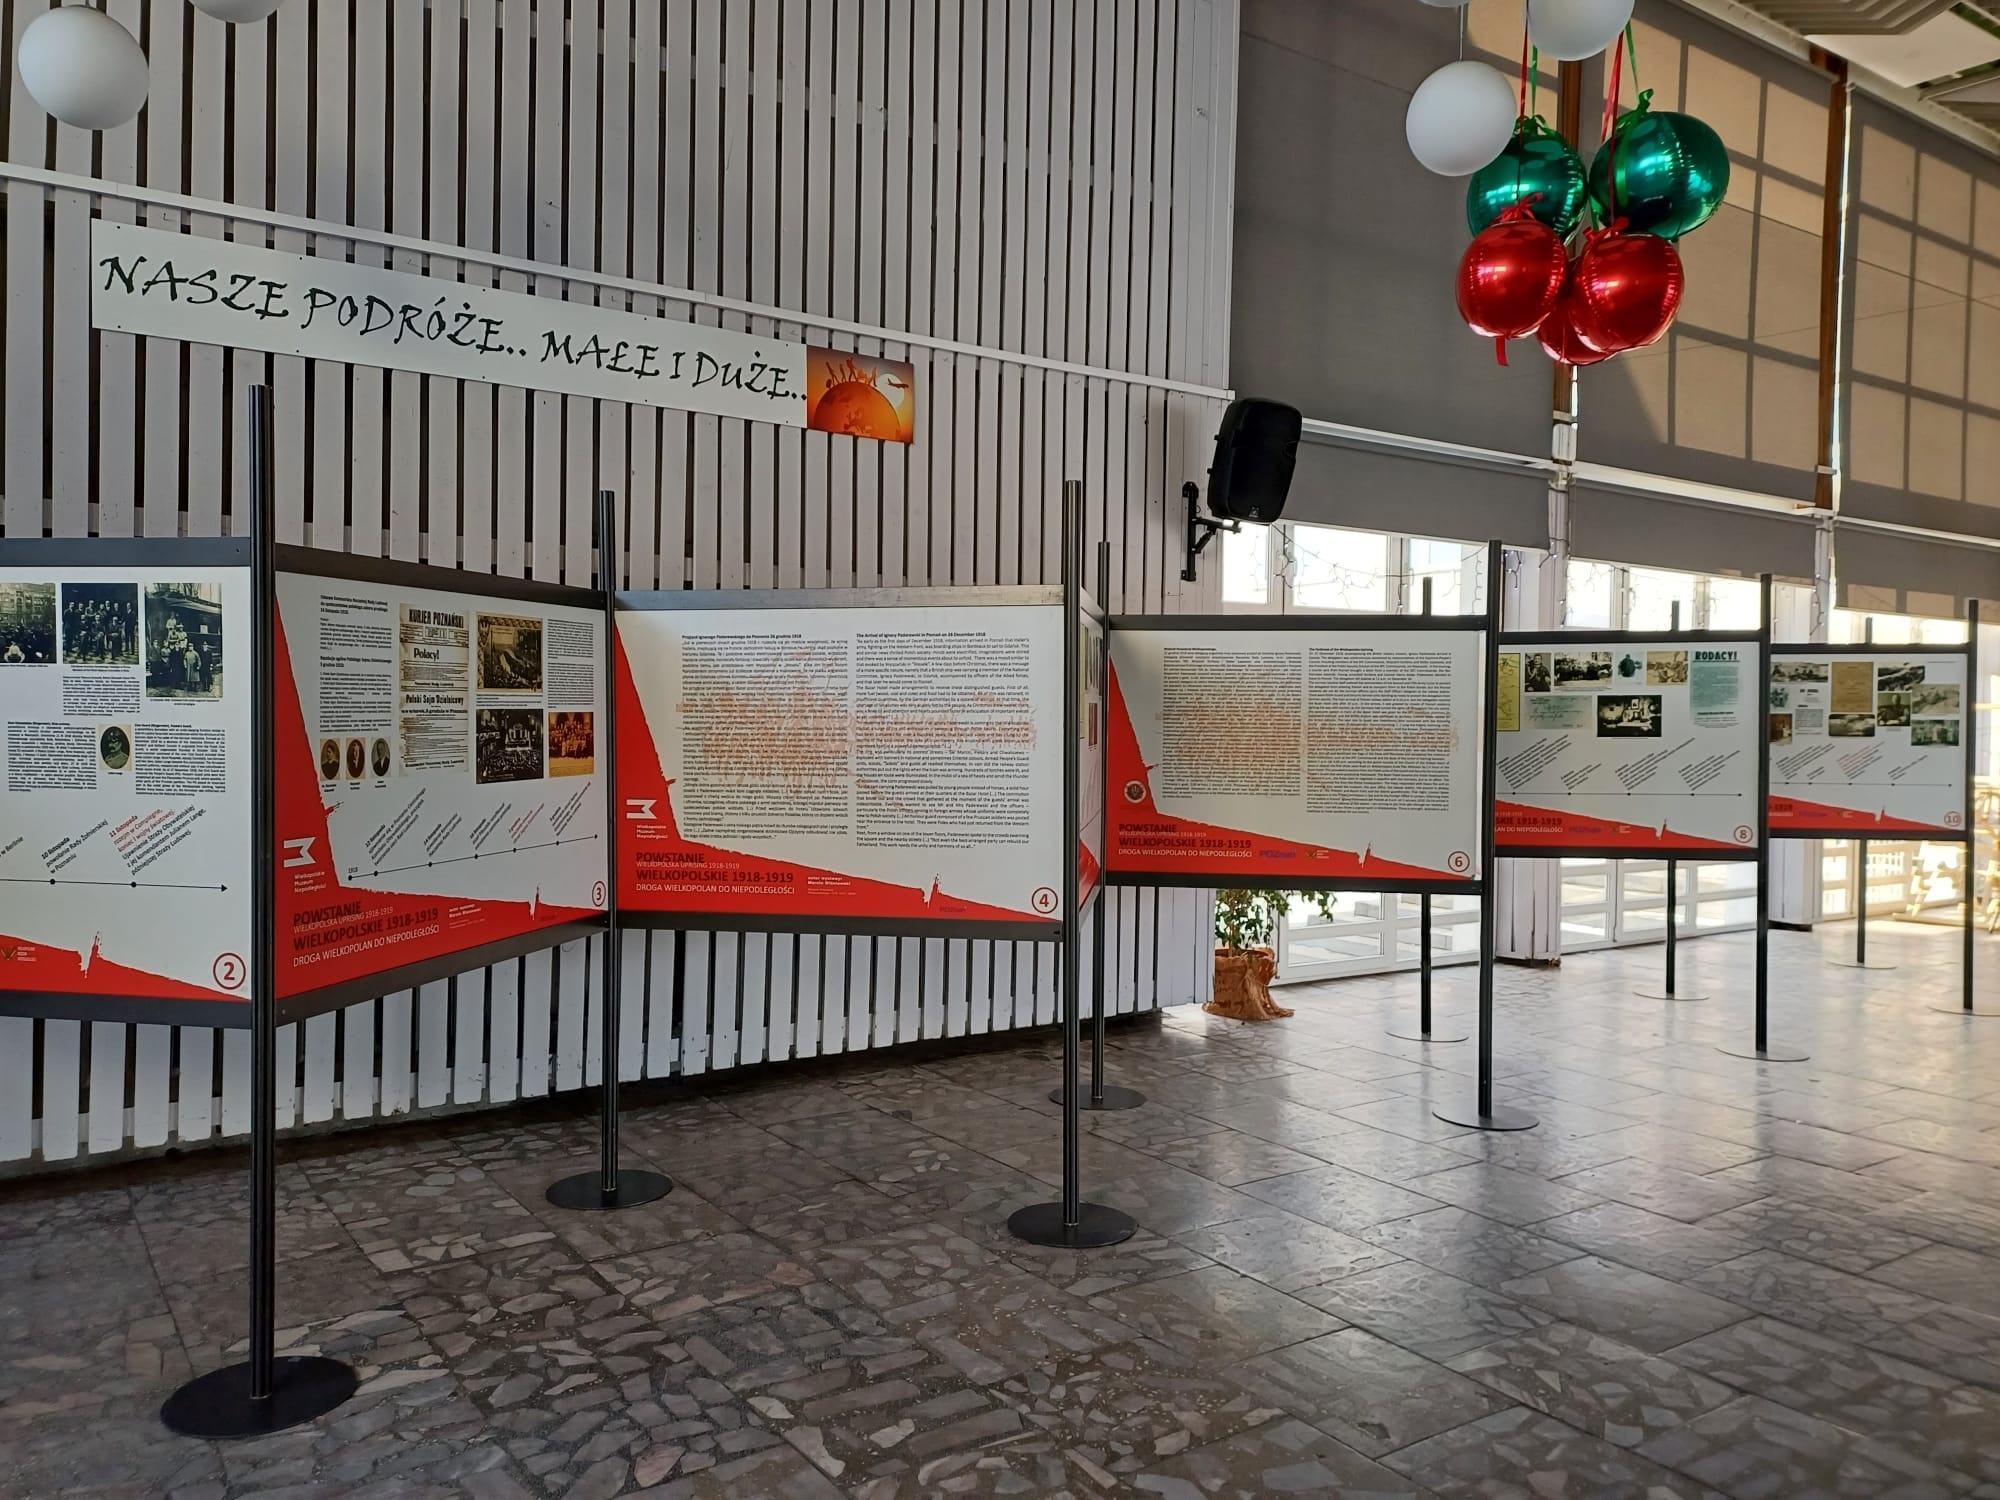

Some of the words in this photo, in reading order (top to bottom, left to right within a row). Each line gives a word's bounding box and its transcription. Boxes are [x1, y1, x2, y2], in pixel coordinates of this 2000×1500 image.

[100, 256, 289, 319] NASZE
[300, 287, 527, 357] PODRÓŻE..
[540, 330, 659, 379] MAŁE
[669, 351, 685, 379] I
[691, 350, 807, 400] DUŻE..
[409, 609, 431, 624] KURJER
[433, 612, 464, 628] POZNAŃSKI
[1695, 651, 1738, 660] RODACY!
[1947, 815, 1959, 824] 10
[1118, 824, 1177, 832] POWSTANIE
[1118, 838, 1197, 848] WIELKOPOLSKIE
[1199, 839, 1252, 849] 1918-1919
[636, 852, 704, 863] POWSTANIE
[1199, 849, 1253, 858] NIEPODLEGŁOŚCI
[1455, 856, 1463, 867] 6
[636, 870, 728, 882] WIELKOPOLSKIE
[732, 872, 793, 883] 1918-1919
[596, 887, 602, 901] 3
[636, 884, 662, 892] DROGA
[664, 884, 716, 893] WIELKOPOLAN
[718, 885, 730, 893] DO
[731, 885, 795, 895] NIEPODLEGŁOŚCI
[1039, 893, 1049, 908] 4
[292, 901, 361, 926] POWSTANIE
[365, 906, 393, 919] 1918-1919
[293, 920, 383, 951] WIELKOPOLSKIE
[386, 908, 438, 930] 1918-1919
[293, 954, 320, 967] DROGA
[322, 940, 373, 960] WIELKOPOLAN
[374, 937, 385, 948] DO
[386, 924, 440, 944] NIEPODLEGŁOŚCI
[223, 961, 235, 981] 2
